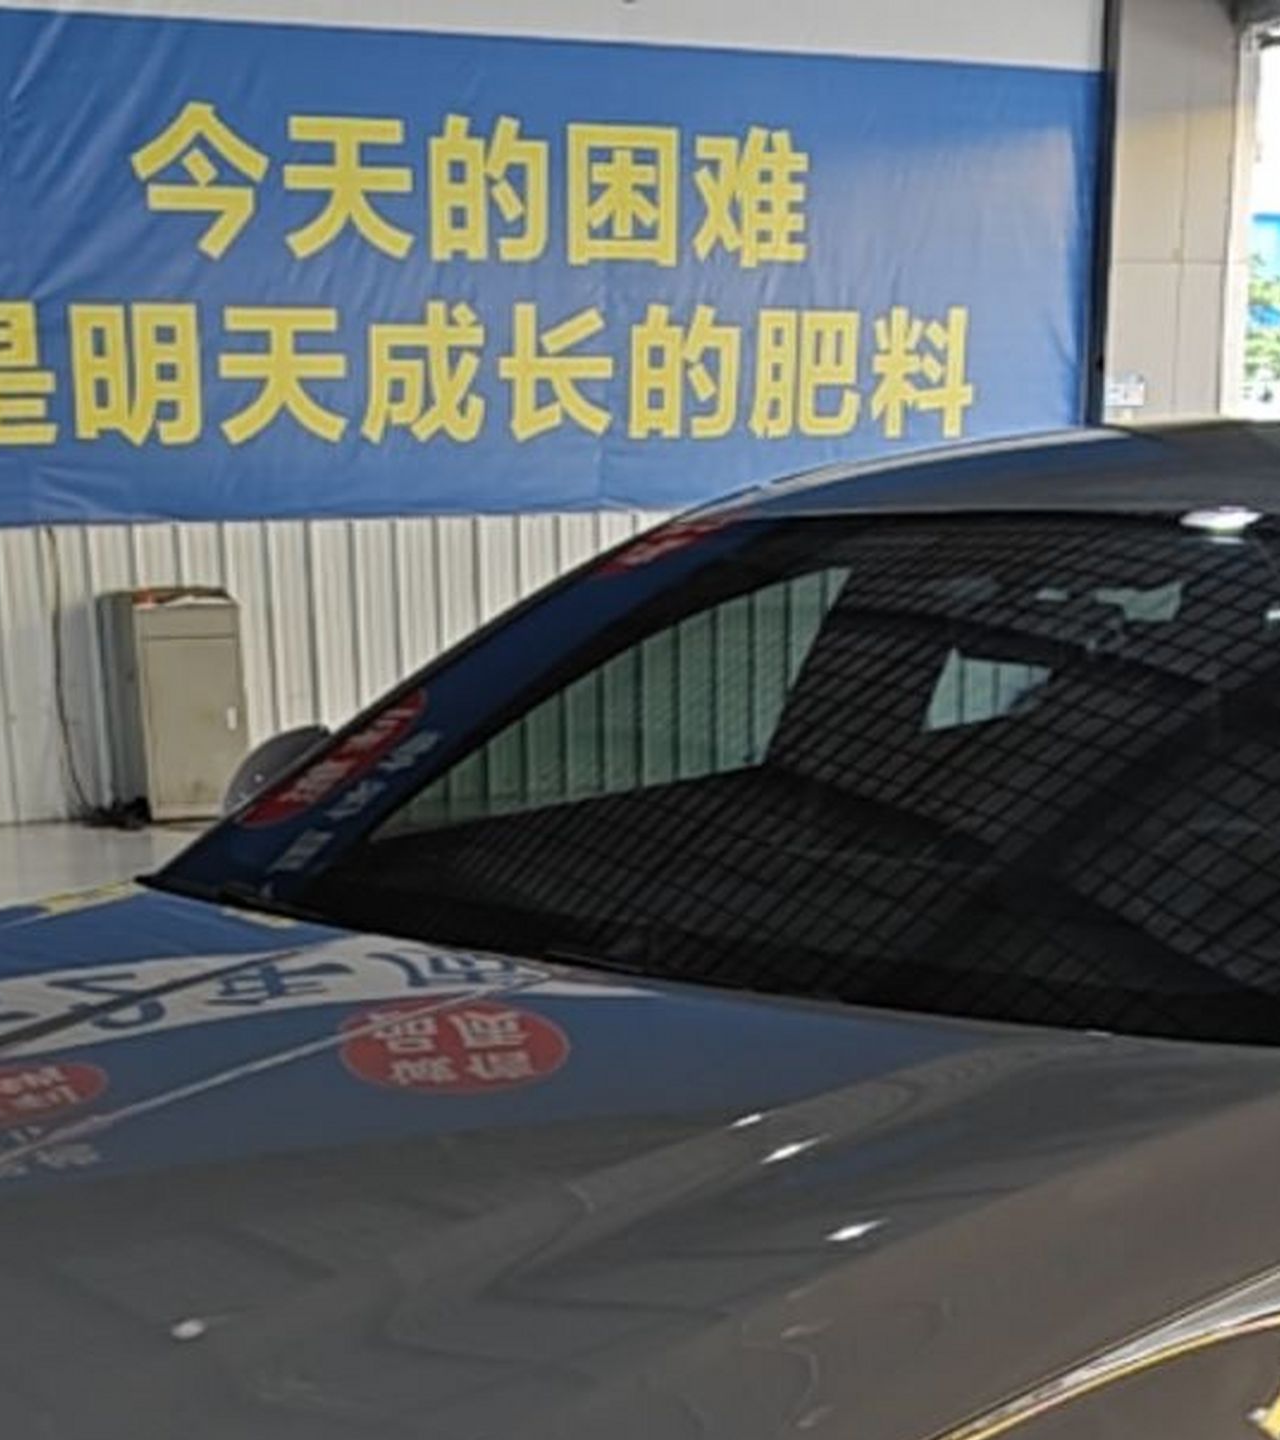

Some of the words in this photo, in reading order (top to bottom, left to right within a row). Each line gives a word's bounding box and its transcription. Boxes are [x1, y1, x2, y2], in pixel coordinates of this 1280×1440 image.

[131, 101, 808, 268] 今天的困难
